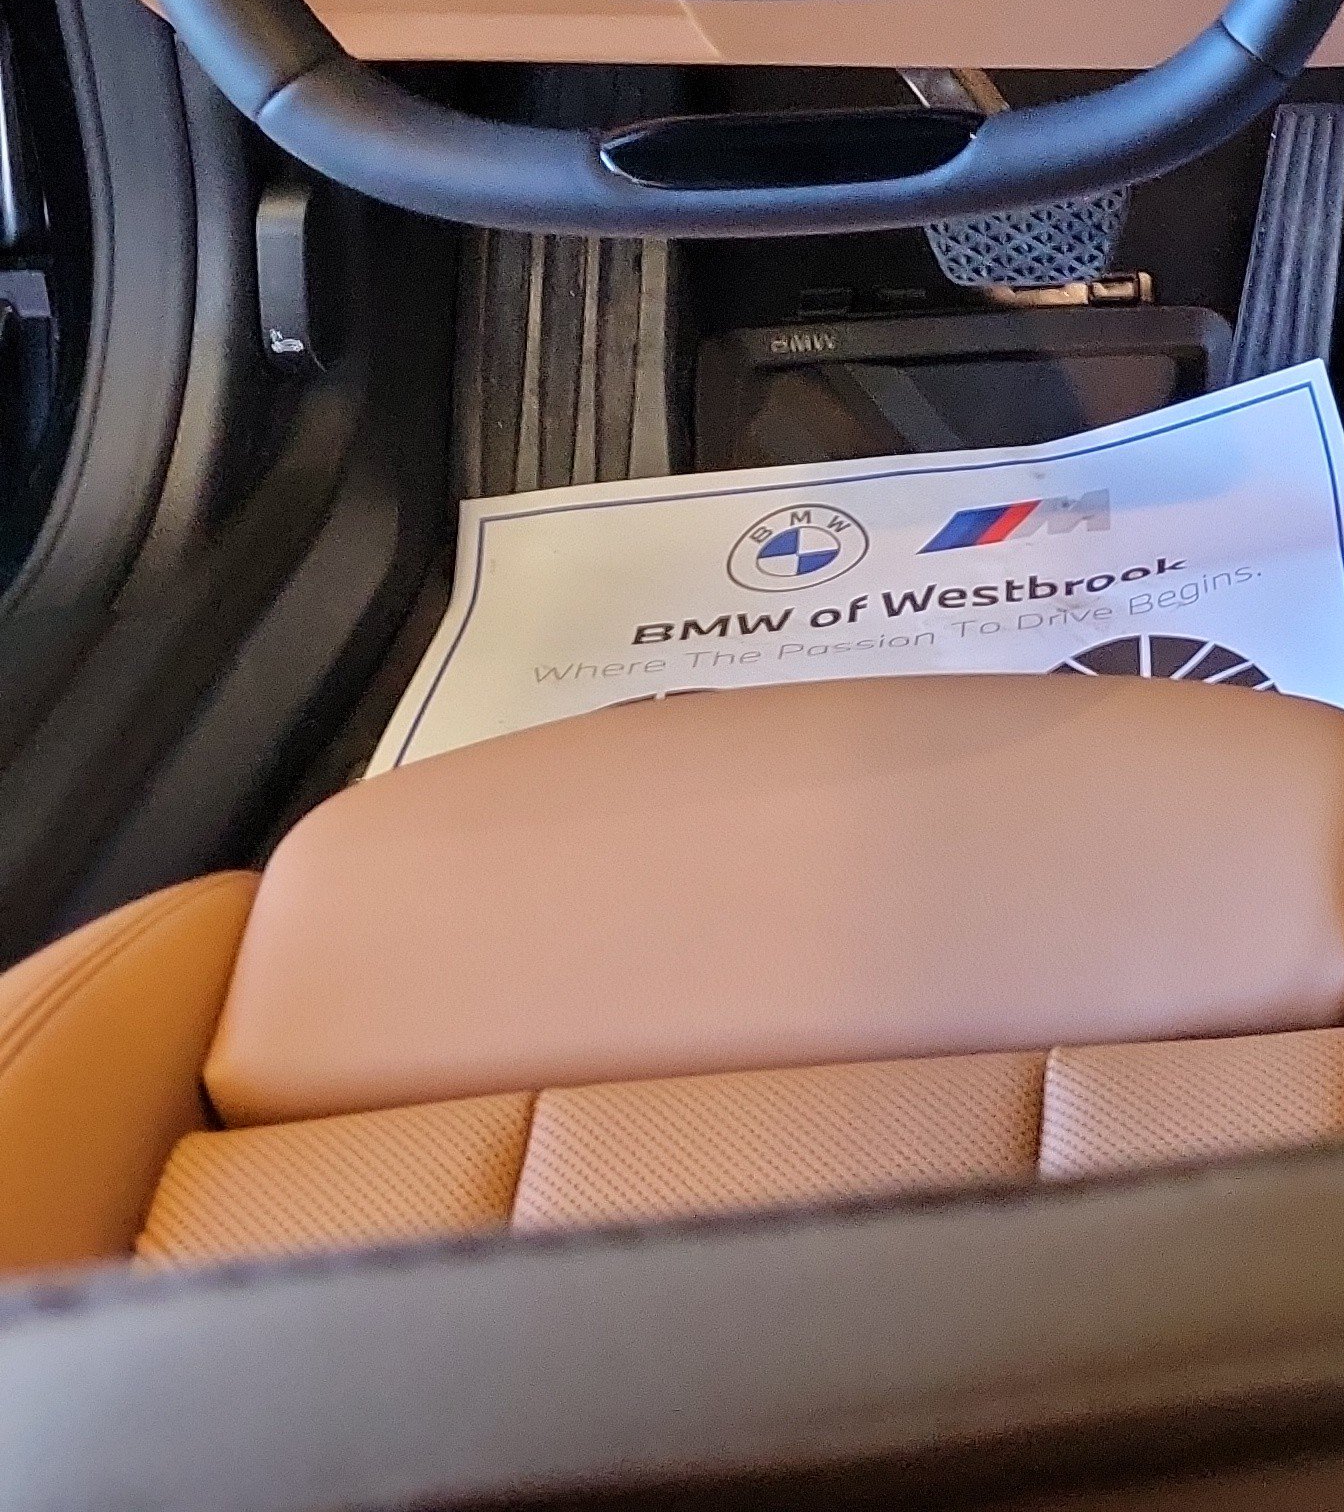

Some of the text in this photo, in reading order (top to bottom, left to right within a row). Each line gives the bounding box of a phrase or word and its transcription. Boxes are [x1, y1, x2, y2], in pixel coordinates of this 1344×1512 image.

[533, 563, 1264, 683] Where The Passion To Drive Begins.
[630, 558, 1190, 648] BMW of Westbrook
